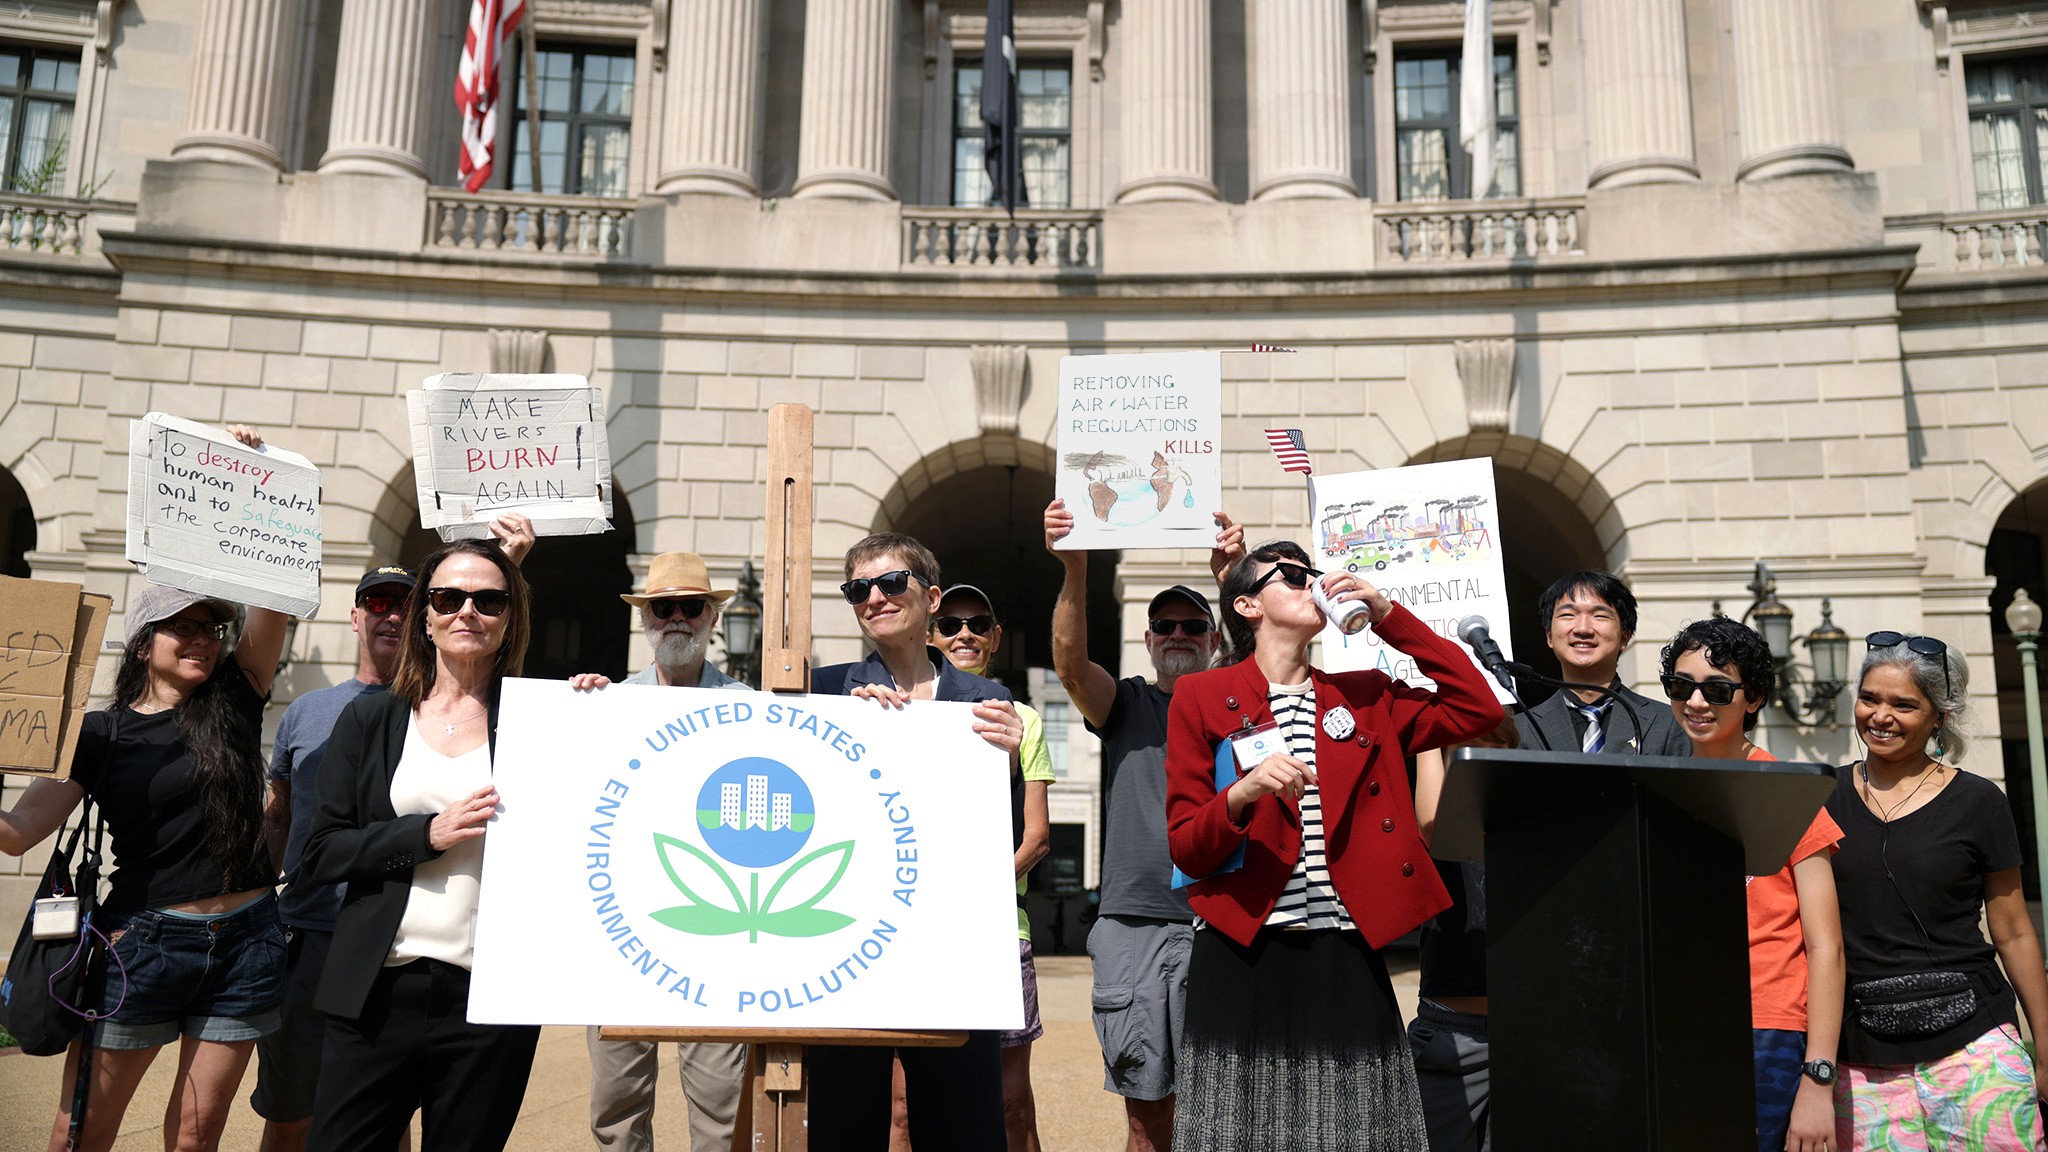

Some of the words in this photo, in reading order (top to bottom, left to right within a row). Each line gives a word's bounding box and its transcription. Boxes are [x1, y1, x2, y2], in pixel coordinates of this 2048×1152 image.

[1073, 375, 1175, 390] REMOVING
[457, 397, 543, 420] MAKE
[1072, 397, 1103, 411] AIR
[1122, 396, 1188, 411] WATER
[443, 426, 546, 443] RIVERS
[1072, 419, 1198, 433] REGULATIONS
[158, 427, 187, 457] To
[197, 442, 275, 486] destroy
[466, 445, 559, 473] BURN
[1164, 440, 1213, 454] KILLS
[157, 482, 197, 503] and
[209, 497, 231, 513] to
[163, 456, 235, 493] human
[253, 485, 316, 516] health
[475, 479, 566, 505] AGAIN
[219, 539, 321, 571] environment
[645, 702, 754, 753] UNITED
[766, 703, 866, 763] STATES
[879, 791, 918, 907] AGENCY
[586, 779, 709, 1008] ENVIRONMENTAL
[737, 919, 899, 1013] POLLUTION
